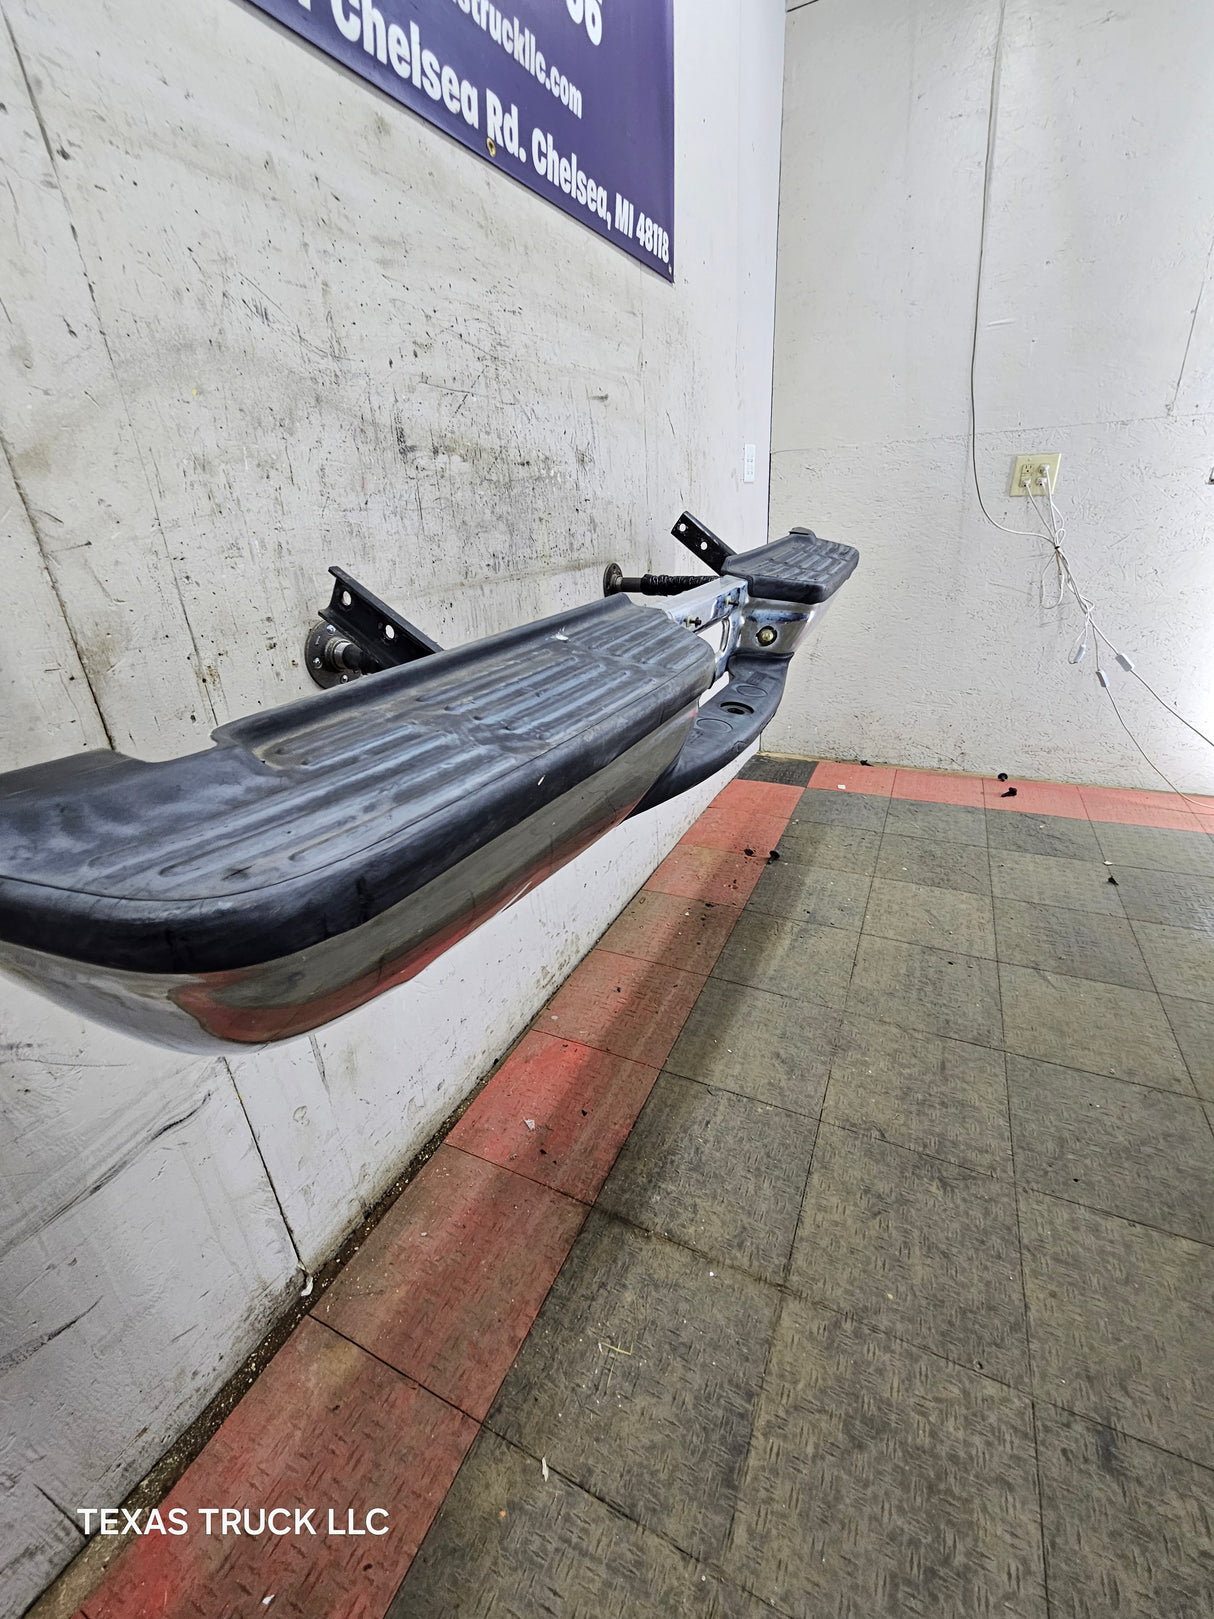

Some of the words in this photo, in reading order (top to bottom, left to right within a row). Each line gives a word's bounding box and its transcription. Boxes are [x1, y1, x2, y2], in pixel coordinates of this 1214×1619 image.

[486, 87, 527, 163] Rd.
[532, 127, 612, 231] Chelsea,
[615, 192, 635, 239] MI
[636, 211, 670, 264] 48118
